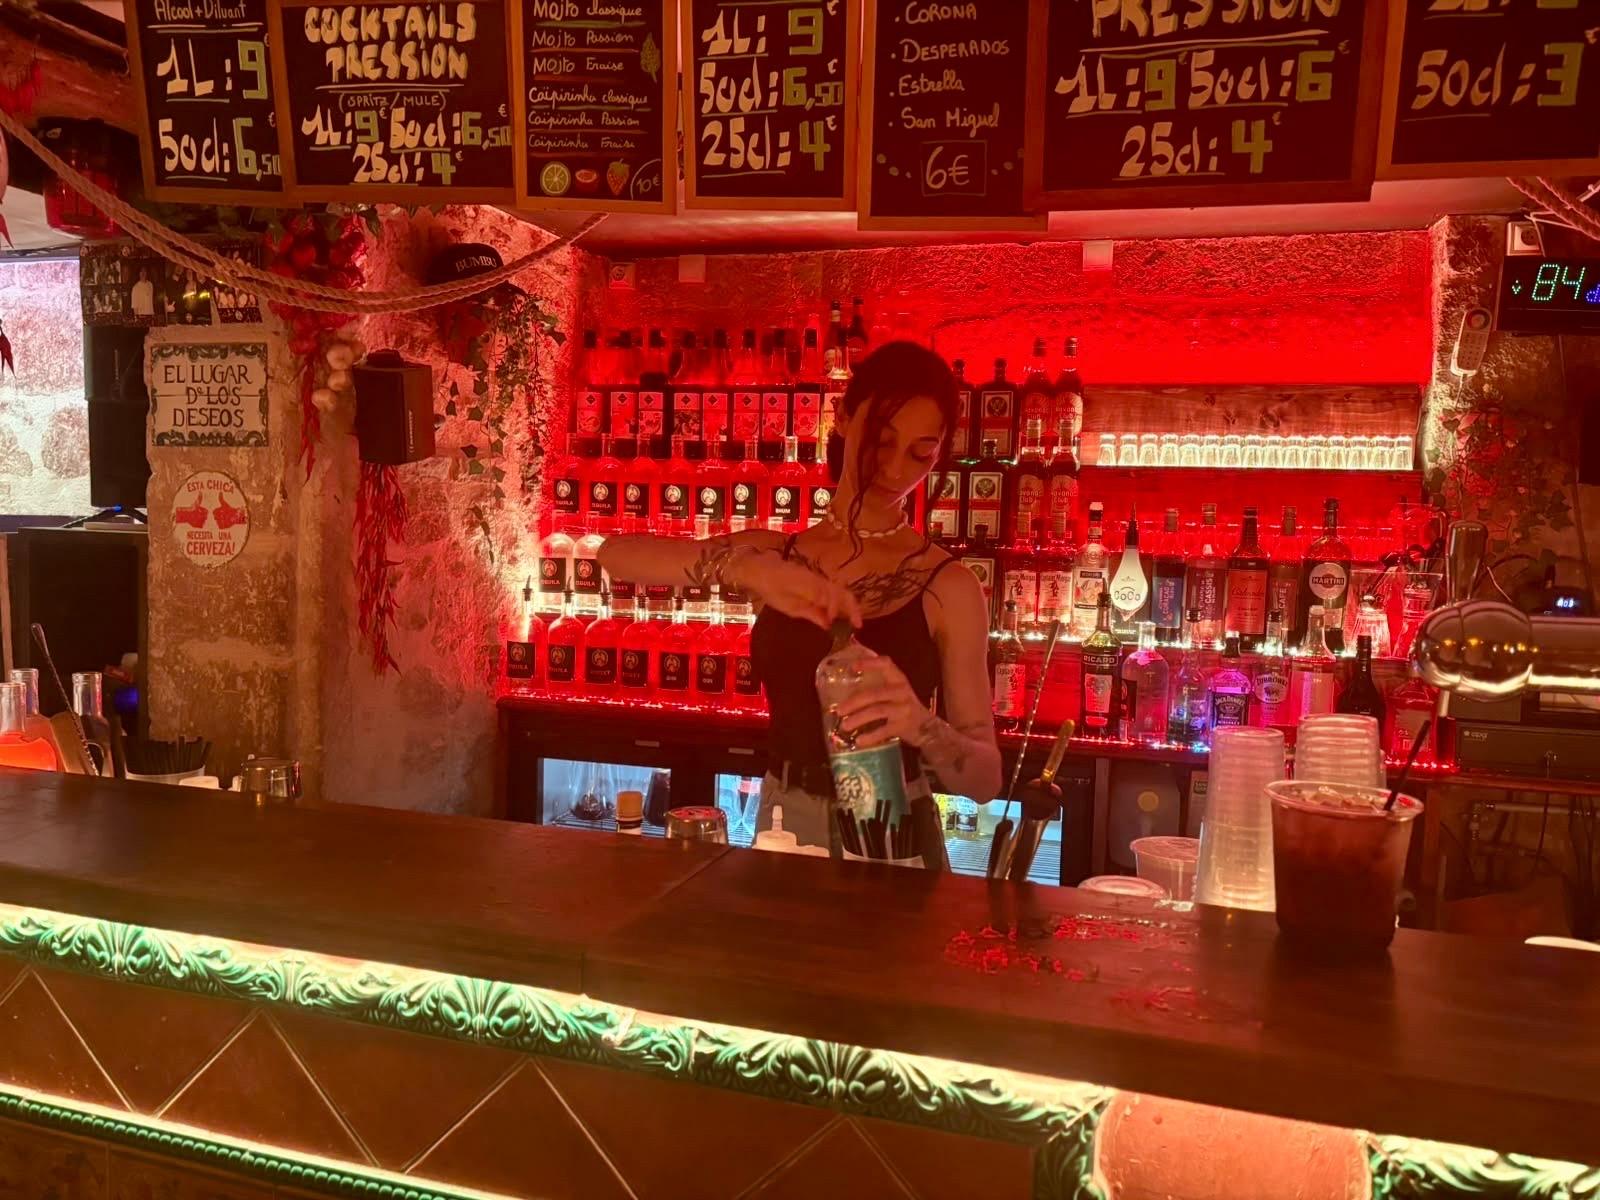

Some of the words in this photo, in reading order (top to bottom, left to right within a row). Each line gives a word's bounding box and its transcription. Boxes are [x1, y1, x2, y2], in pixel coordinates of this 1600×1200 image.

[586, 30, 634, 45] Passion
[586, 57, 624, 71] Fraise
[899, 69, 966, 96] Estrella
[602, 89, 648, 110] classique
[601, 111, 640, 126] Passion
[901, 107, 936, 129] San
[945, 103, 1000, 137] Miguel
[926, 147, 970, 189] 6€
[455, 256, 497, 272] BUMBU
[1531, 263, 1586, 301] 84
[164, 365, 186, 383] EL
[191, 365, 252, 384] LUGAR
[206, 386, 242, 406] LOS
[173, 408, 244, 427] DESEOS
[187, 481, 205, 492] ESTA
[207, 479, 234, 493] CHICA
[187, 531, 213, 540] NECESITA
[218, 531, 232, 540] UNA
[187, 541, 235, 556] CERVEZA!
[1312, 576, 1345, 586] MARTINI
[1083, 654, 1116, 664] RICARD
